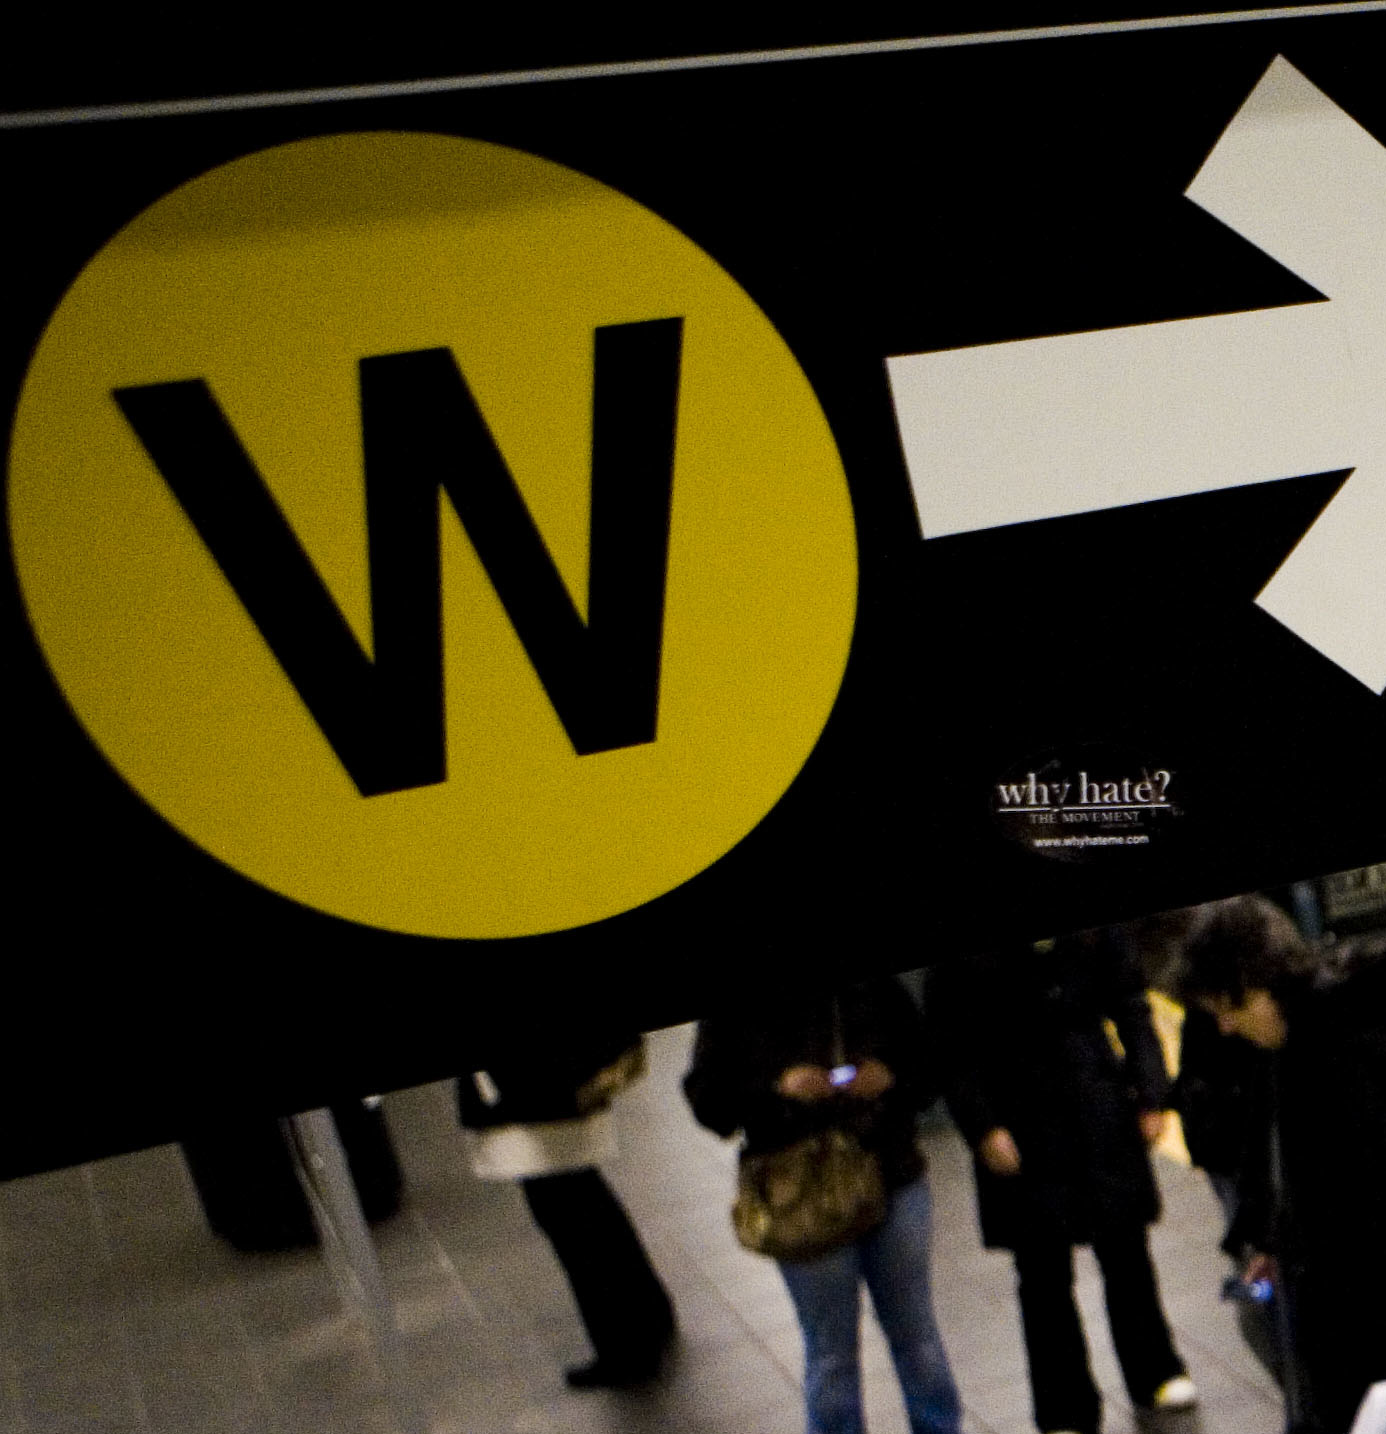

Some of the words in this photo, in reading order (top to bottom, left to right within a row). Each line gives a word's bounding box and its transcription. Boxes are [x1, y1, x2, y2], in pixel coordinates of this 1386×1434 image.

[112, 317, 684, 798] W
[998, 771, 1070, 808] why
[1079, 769, 1172, 804] hate?
[1031, 813, 1057, 825] THE
[1063, 810, 1141, 825] MOVEMENT
